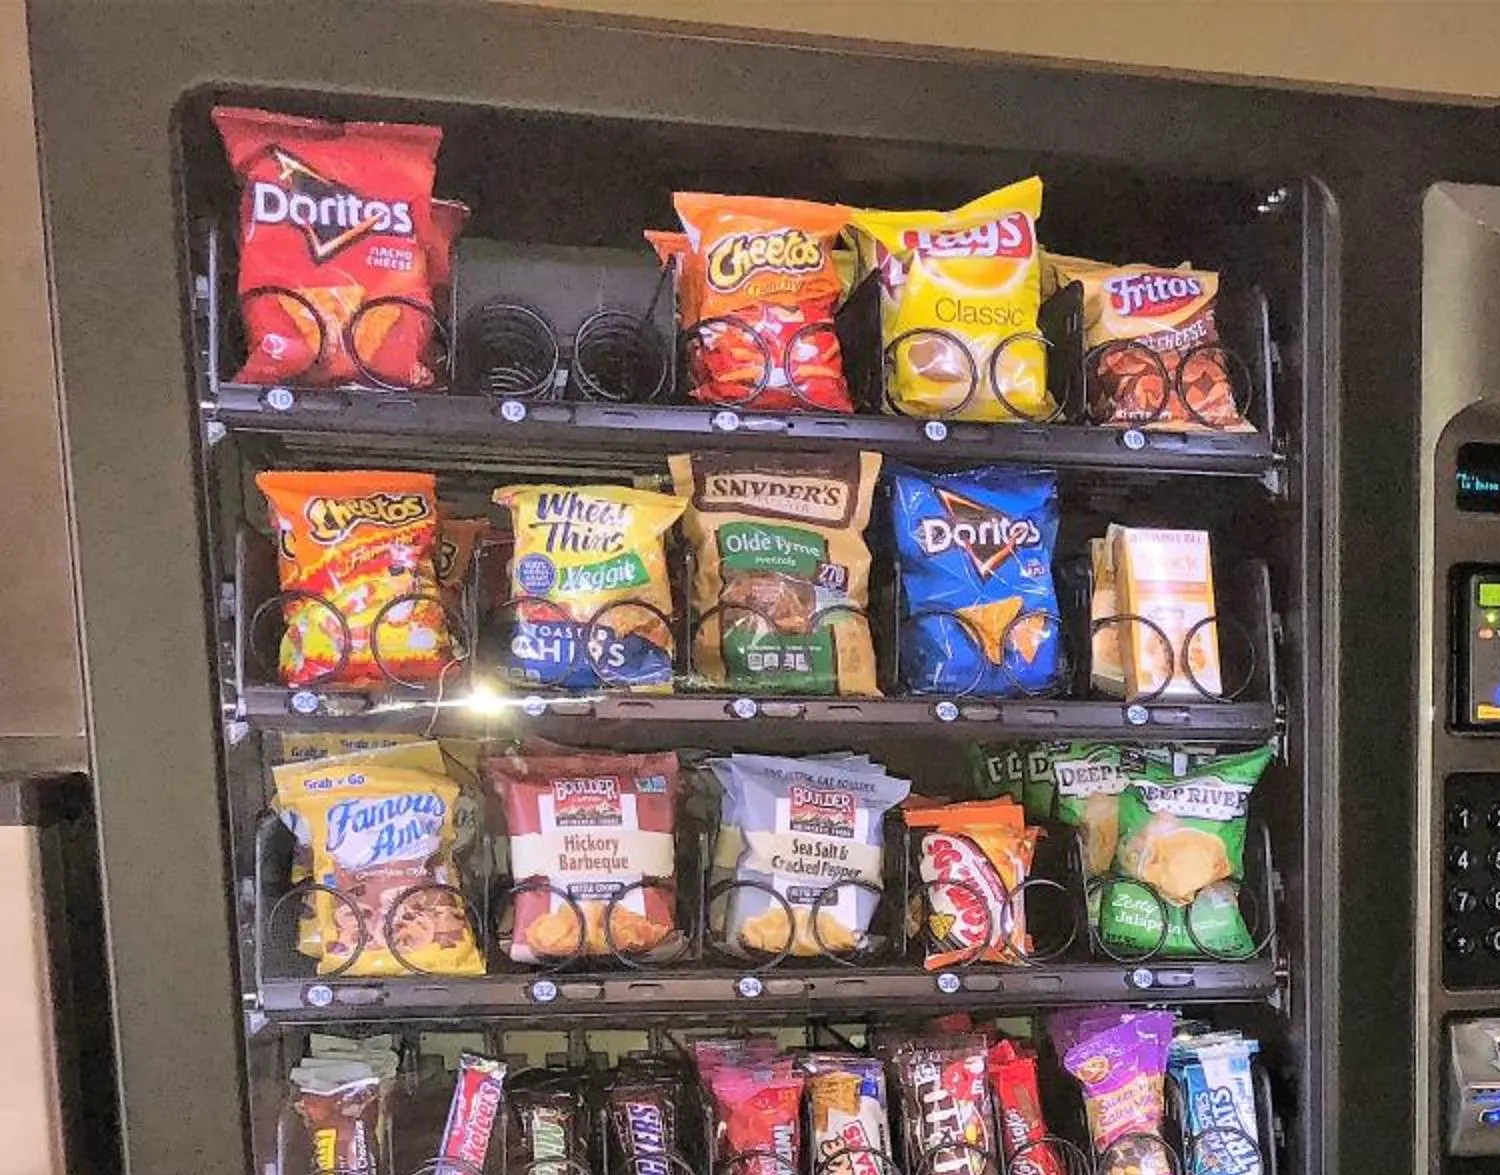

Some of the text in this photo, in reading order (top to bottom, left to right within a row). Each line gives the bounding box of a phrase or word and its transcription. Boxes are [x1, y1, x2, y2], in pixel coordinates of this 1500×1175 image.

[254, 181, 413, 233] Doritos
[366, 258, 413, 271] CHEESE
[710, 231, 821, 288] Cheetos
[1104, 276, 1202, 316] Fritos
[934, 297, 1025, 328] Classic
[271, 393, 290, 406] 10
[505, 405, 522, 417] 12
[928, 425, 944, 436] 16
[712, 478, 841, 506] SNYDER'S
[309, 497, 423, 540] Cheetos
[726, 532, 771, 553] Olde
[921, 517, 1041, 554] Doritos
[562, 556, 638, 592] Veggie
[524, 624, 608, 641] TOASTD
[512, 636, 625, 668] HIPS
[940, 706, 956, 717] 26
[1059, 764, 1112, 787] DEEP
[326, 792, 447, 852] Famous
[1459, 808, 1469, 829] 1
[563, 834, 619, 856] Hickory
[792, 837, 814, 857] Sea
[814, 841, 838, 860] Salt
[558, 852, 630, 874] Barbeque
[771, 854, 863, 882] Cracked Pepper
[1457, 850, 1469, 870] 4
[1457, 891, 1469, 912] 7
[536, 985, 553, 997] 32
[740, 982, 758, 994] 34
[940, 978, 958, 990] 36
[311, 988, 330, 1003] 30
